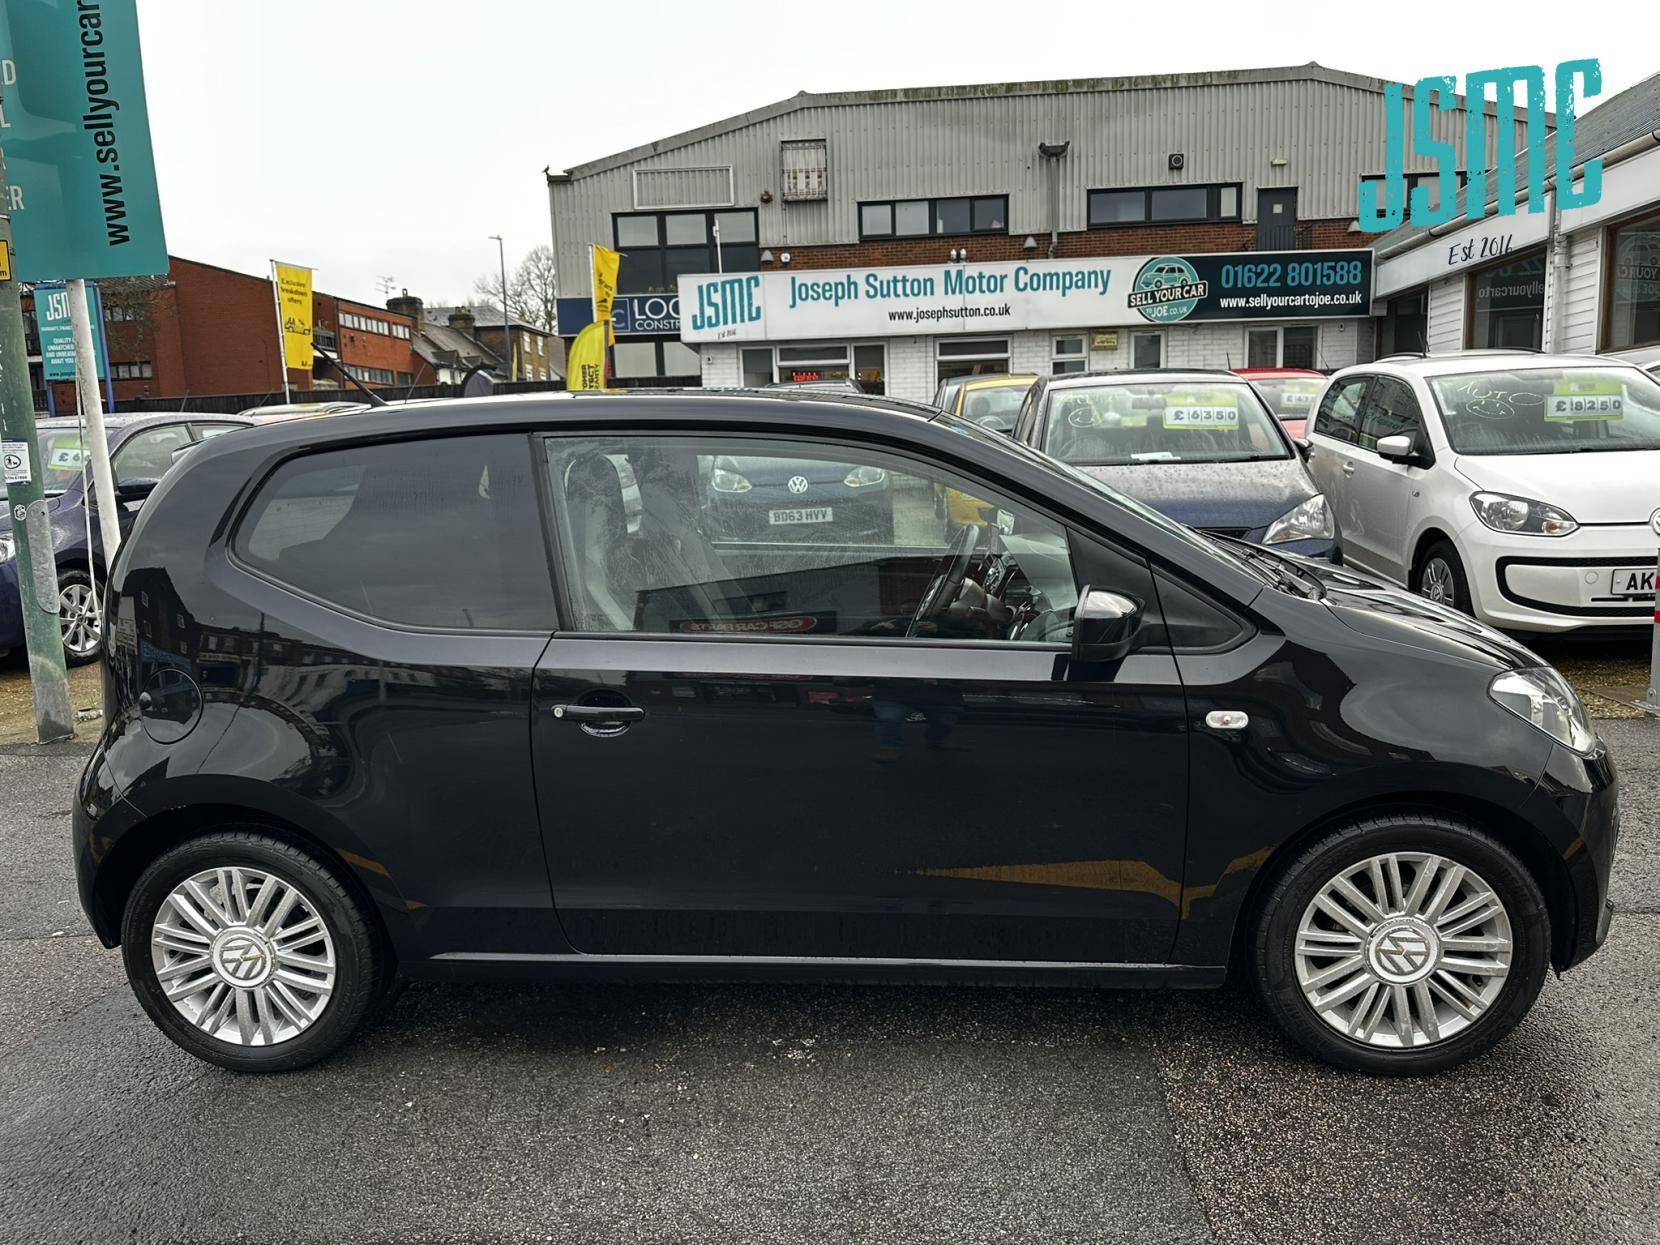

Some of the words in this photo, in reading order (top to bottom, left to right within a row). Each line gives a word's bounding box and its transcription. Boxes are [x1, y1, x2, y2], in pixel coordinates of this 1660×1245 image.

[1448, 238, 1475, 266] Est
[1480, 234, 1513, 258] 2016
[1220, 263, 1281, 288] 01622
[1286, 260, 1362, 287] 801588
[789, 274, 858, 309] Joseph
[865, 271, 934, 299] Sutton
[943, 267, 1008, 296] Motor
[1014, 265, 1112, 297] Company
[1129, 292, 1151, 307] SELL
[1153, 286, 1182, 303] YOUR
[1182, 281, 1205, 298] CAR
[691, 275, 762, 331] JSMC
[1219, 290, 1363, 310] www.sellyourcartojoe.co.uk
[888, 303, 1011, 323] www.josephsutton.co.uk
[1173, 409, 1237, 421] £6350
[1554, 400, 1622, 413] £8250
[804, 509, 828, 521] HVV
